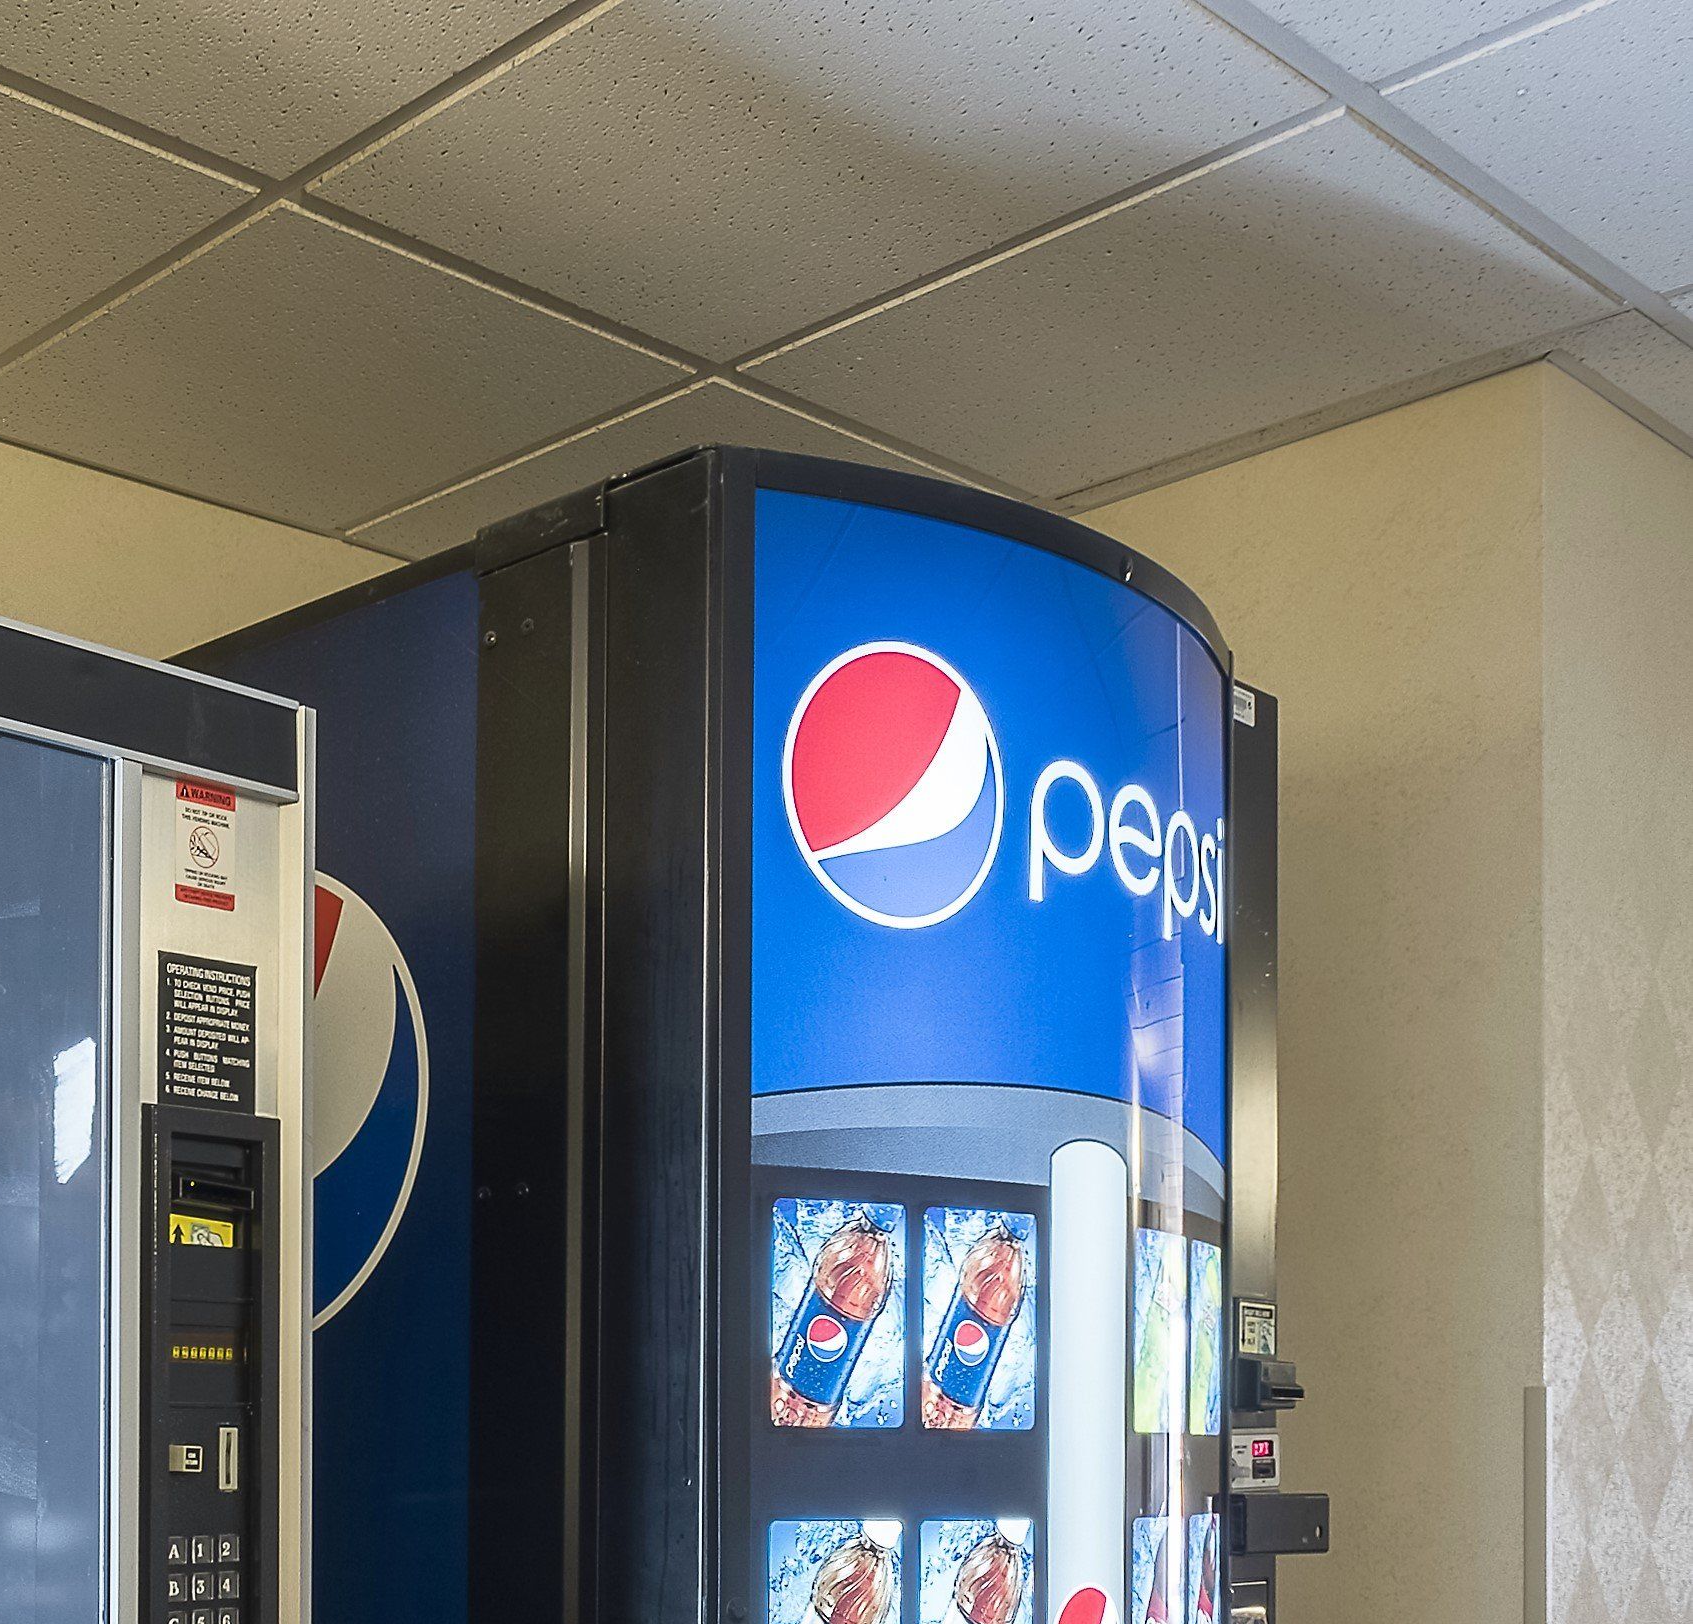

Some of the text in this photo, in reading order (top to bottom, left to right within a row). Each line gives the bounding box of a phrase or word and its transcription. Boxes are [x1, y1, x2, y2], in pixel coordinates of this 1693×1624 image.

[190, 787, 232, 807] WARNING
[1028, 759, 1225, 946] pepsi
[167, 962, 251, 987] OPERATING INSTRUCTIONS
[168, 1544, 180, 1560] A
[196, 1543, 204, 1558] 1
[222, 1541, 232, 1557] 2
[168, 1580, 180, 1597] B
[196, 1579, 205, 1594] 3
[222, 1578, 231, 1593] 4
